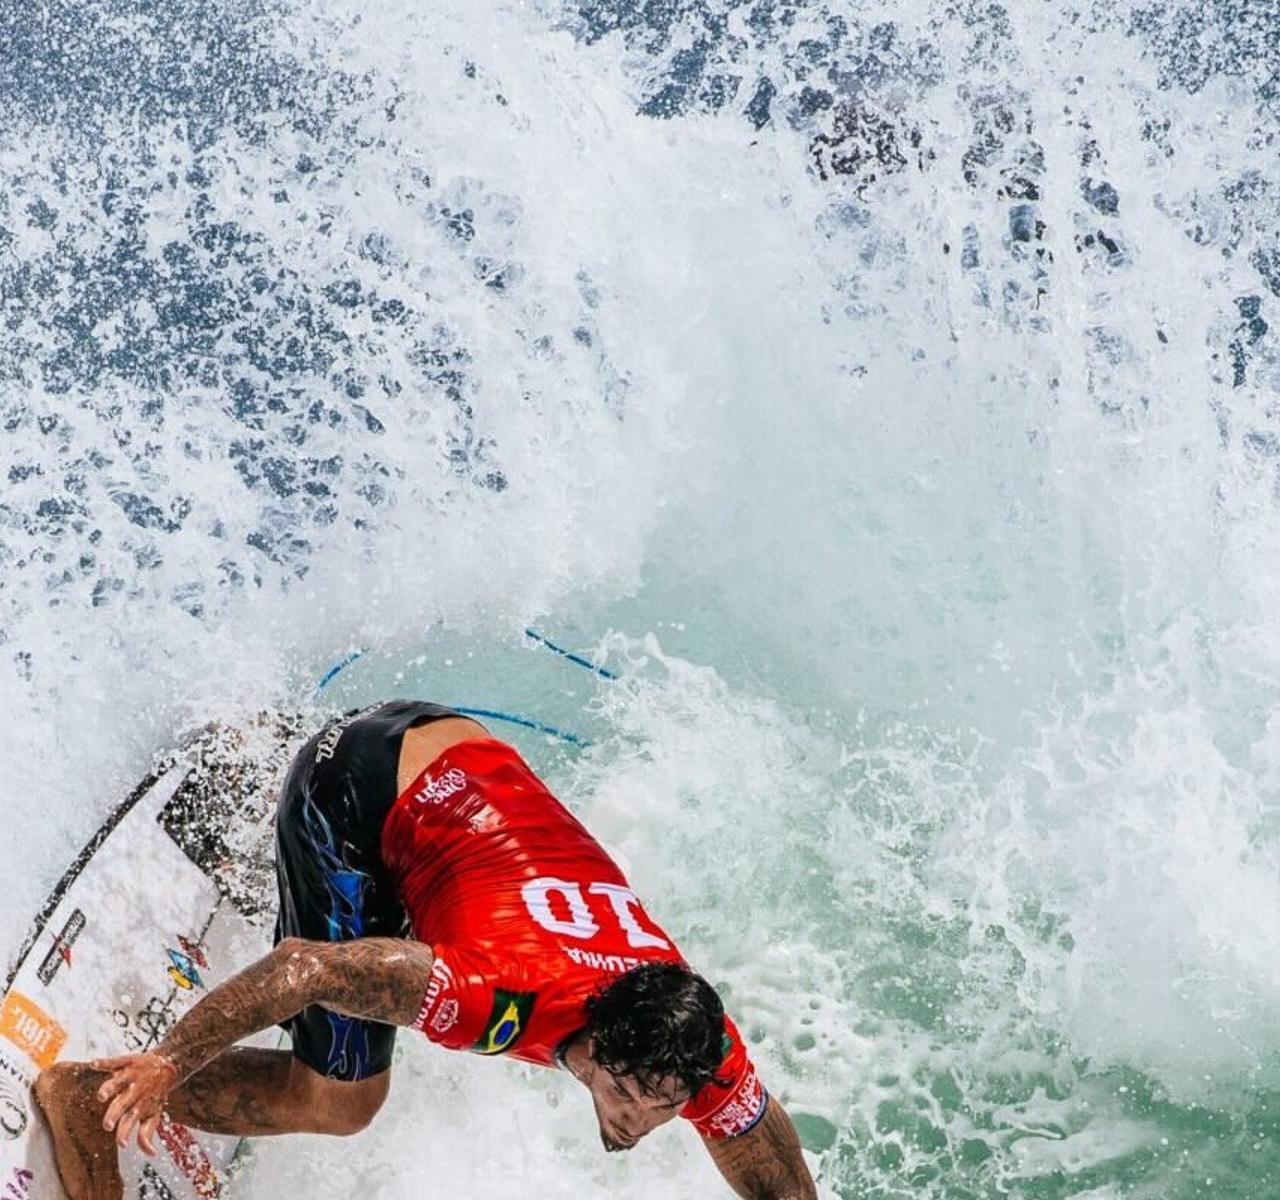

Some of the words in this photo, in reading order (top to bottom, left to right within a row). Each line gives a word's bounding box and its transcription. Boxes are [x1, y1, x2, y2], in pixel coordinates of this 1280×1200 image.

[521, 877, 670, 950] 10
[561, 946, 649, 973] EDINA
[12, 1006, 52, 1052] JBL
